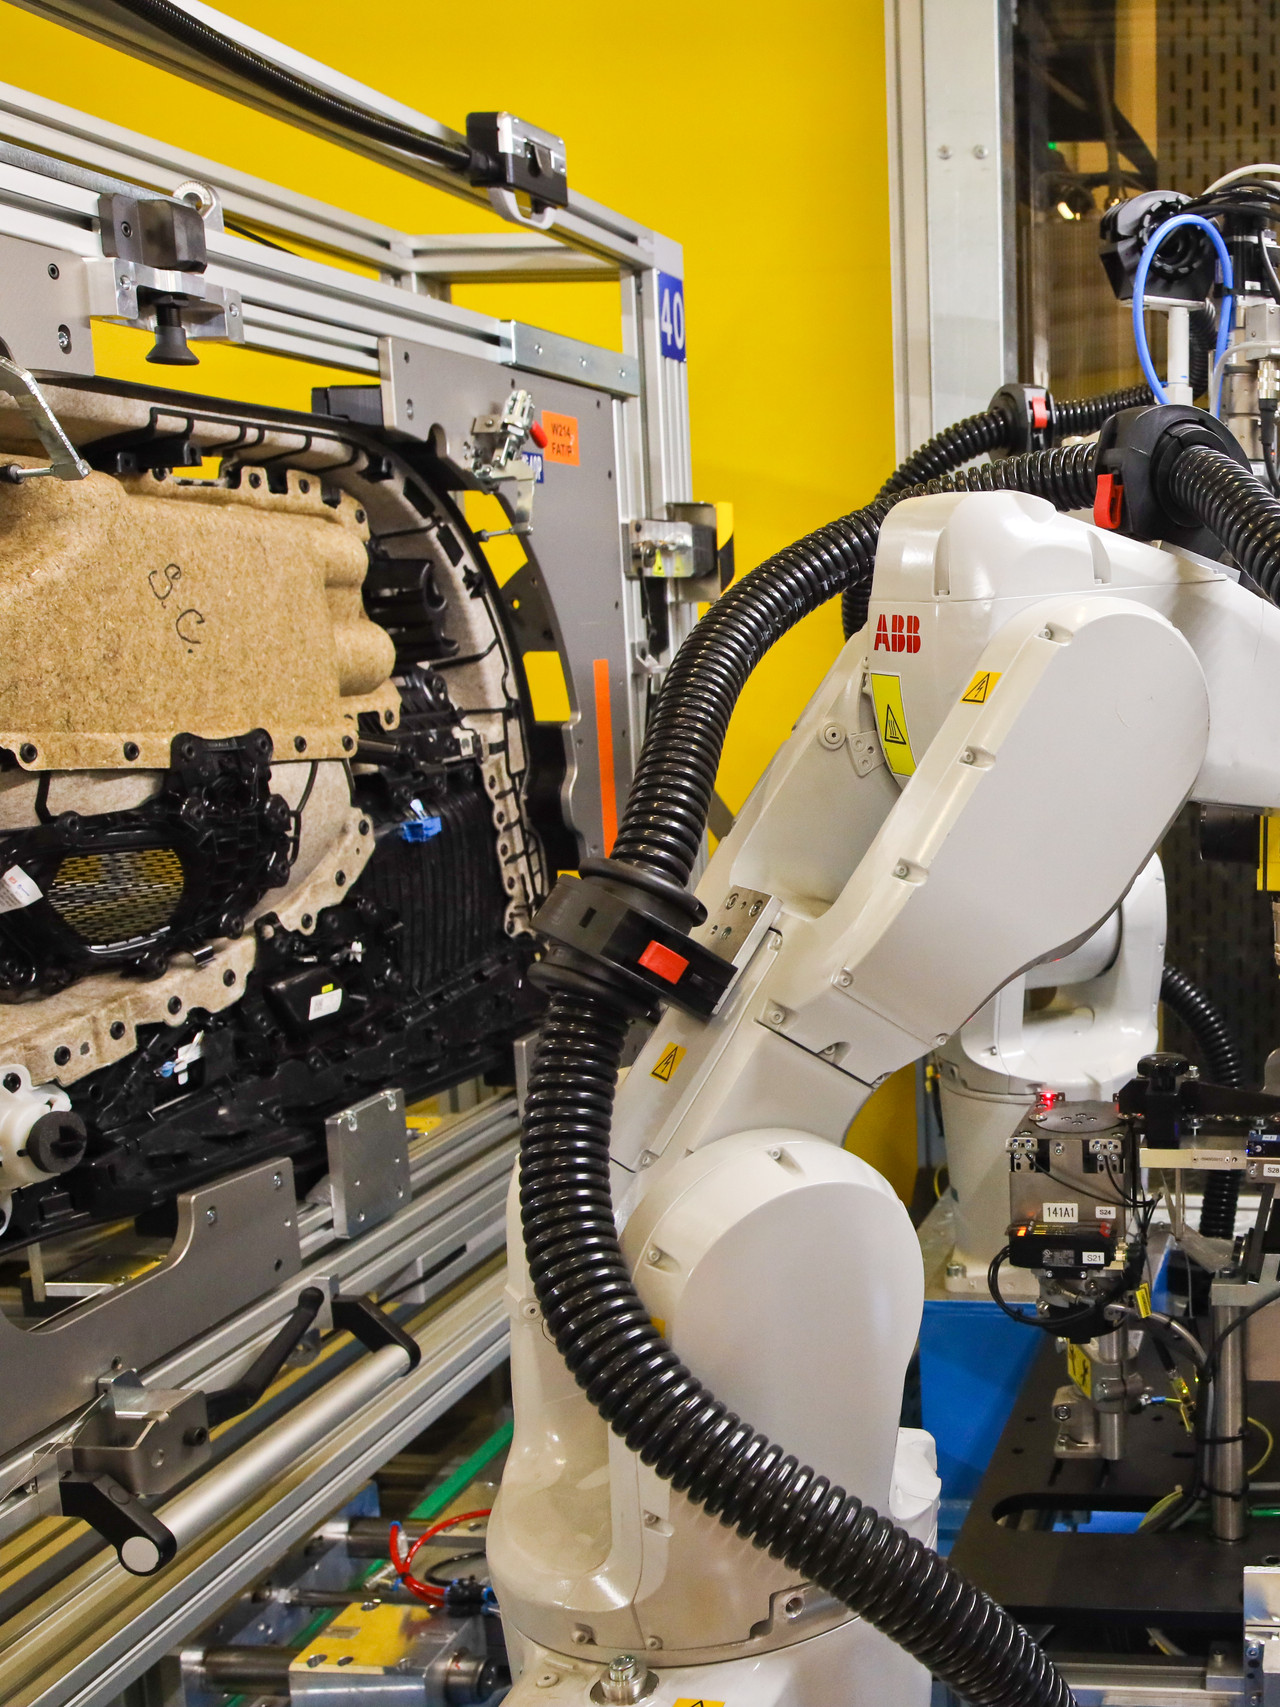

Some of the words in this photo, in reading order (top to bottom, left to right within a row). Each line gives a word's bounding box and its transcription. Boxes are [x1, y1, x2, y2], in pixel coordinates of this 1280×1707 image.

[661, 288, 685, 350] 40
[874, 614, 922, 654] ABB
[1267, 1166, 1280, 1174] S28
[1047, 1207, 1075, 1218] 141A1
[1087, 1254, 1101, 1262] S21
